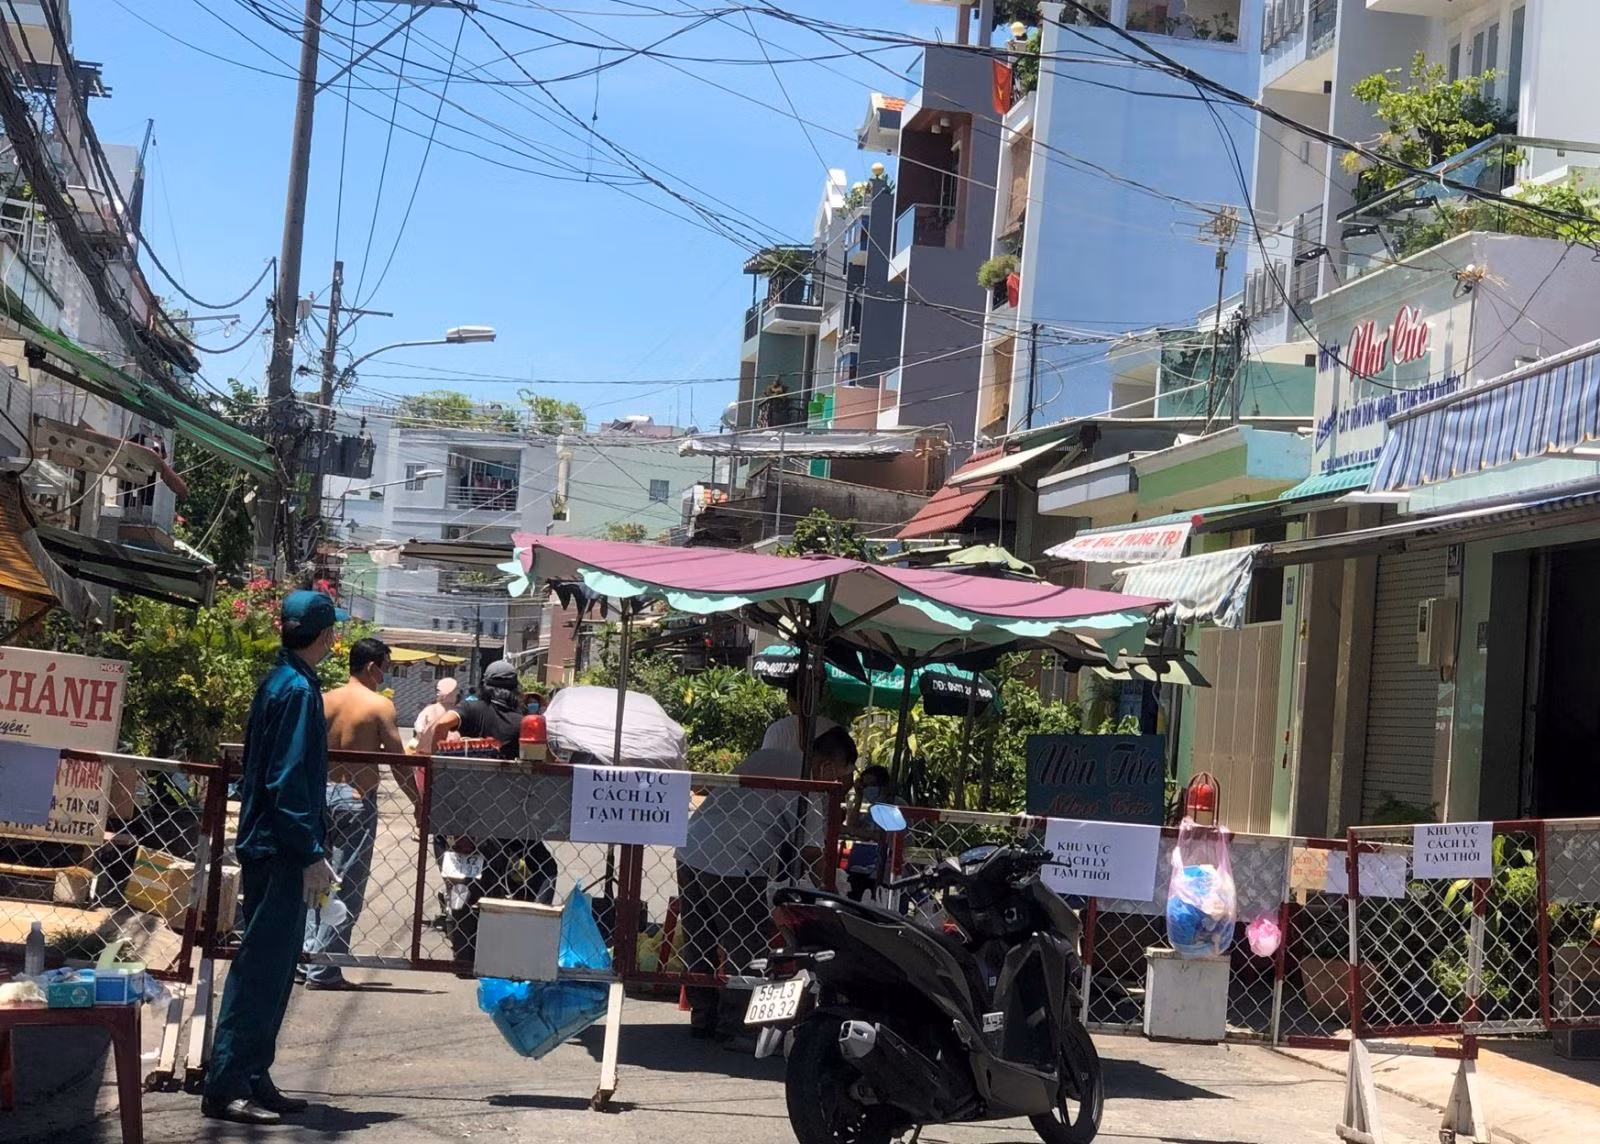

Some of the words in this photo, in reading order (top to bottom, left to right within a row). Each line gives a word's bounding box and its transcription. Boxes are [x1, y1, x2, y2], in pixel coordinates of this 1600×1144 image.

[0, 661, 118, 722] HÁNH
[592, 769, 630, 784] KHU
[592, 785, 640, 802] CÁCH
[645, 790, 668, 804] LY
[586, 806, 624, 824] TẠM
[628, 806, 670, 824] THỜI
[1427, 827, 1451, 836] KHU
[1454, 824, 1479, 837] VỰC
[1057, 841, 1083, 852] KHU
[1086, 841, 1111, 856] VỰC
[1427, 837, 1459, 849] CÁCH
[1462, 839, 1478, 849] LY
[1056, 852, 1089, 867] CÁCH
[1092, 857, 1110, 868] LY
[1424, 851, 1449, 865] TẠM
[1451, 849, 1480, 862] THỜI
[1053, 867, 1078, 879] TẠM
[1081, 868, 1111, 881] THỜI
